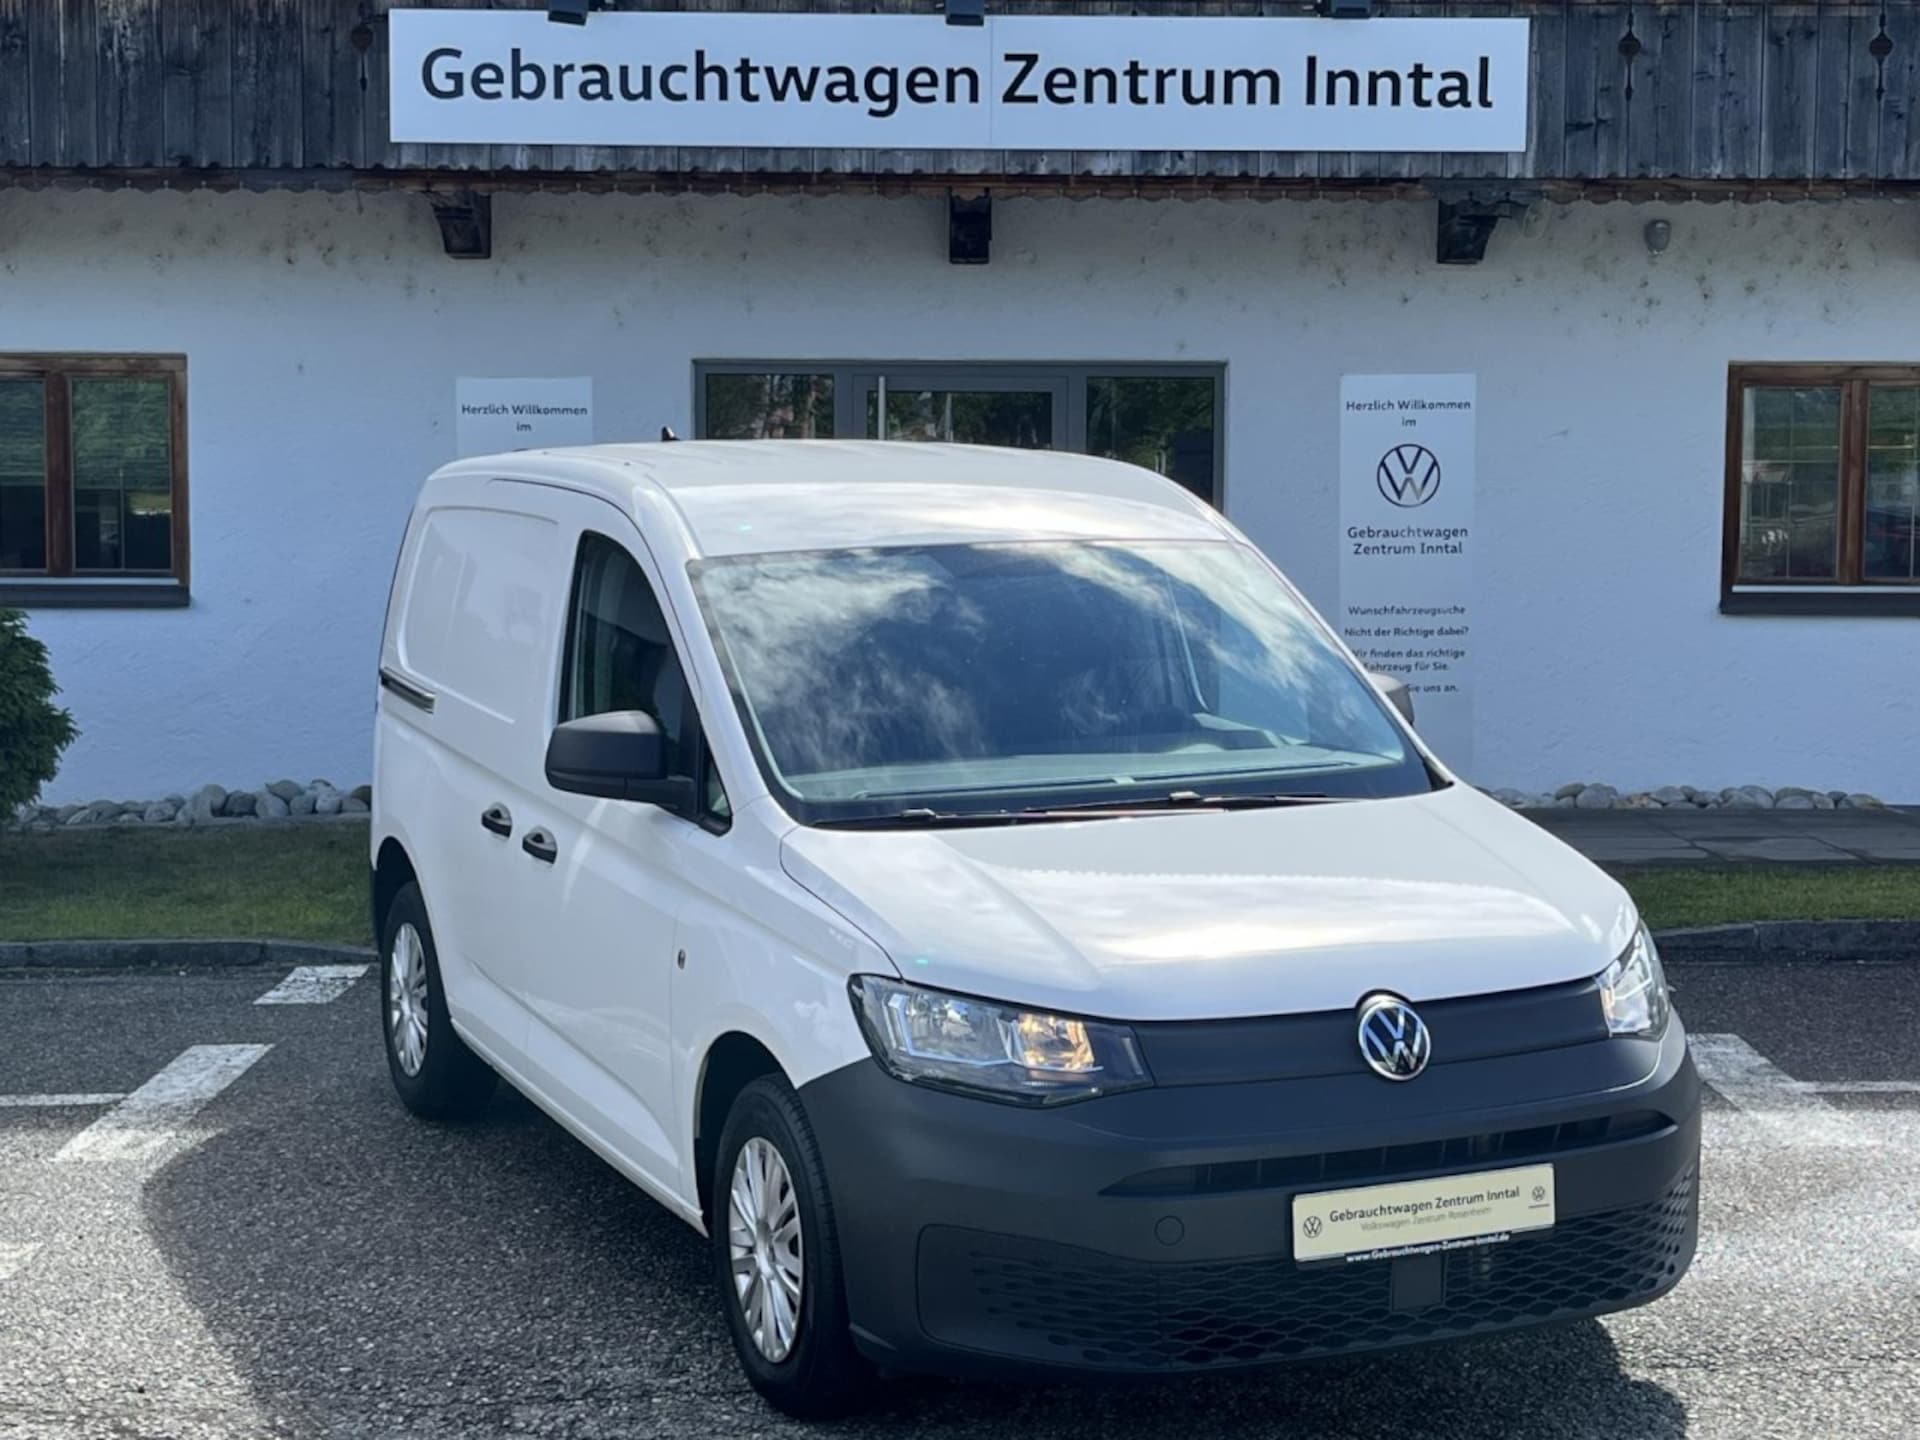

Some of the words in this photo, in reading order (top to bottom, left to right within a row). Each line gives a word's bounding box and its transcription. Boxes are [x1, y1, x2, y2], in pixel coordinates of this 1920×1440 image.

[421, 47, 979, 118] Gebrauchtwagen
[1002, 53, 1281, 105] Zentrum
[1306, 55, 1493, 108] Inntal
[461, 404, 509, 415] Herzlich
[512, 404, 588, 415] Willkommen
[1346, 400, 1395, 411] Herzlich
[1398, 400, 1471, 411] Willkommen
[516, 422, 532, 432] im
[1402, 416, 1417, 427] im
[1347, 525, 1468, 540] Gebrauchtwagen
[1354, 543, 1416, 556] Zentrum
[1420, 541, 1463, 555] Inntal
[1348, 606, 1466, 617] Wunschfahrzeugsuche
[1345, 626, 1372, 637] Nicht
[1374, 626, 1391, 637] der
[1393, 626, 1435, 639] Richtige
[1437, 625, 1469, 637] dabei?
[1370, 648, 1404, 658] finden
[1406, 648, 1424, 658] das
[1426, 648, 1466, 660] richtige
[1414, 661, 1430, 671] für
[1432, 661, 1450, 671] Sie.
[1423, 684, 1441, 692] uns
[1444, 684, 1459, 692] an.
[1329, 1201, 1433, 1223] Gebrauchtwagen
[1435, 1191, 1484, 1209] Zentrum
[1486, 1186, 1520, 1201] Inntal
[1361, 1216, 1411, 1232] Volkswagen
[1412, 1211, 1447, 1225] Zentrum
